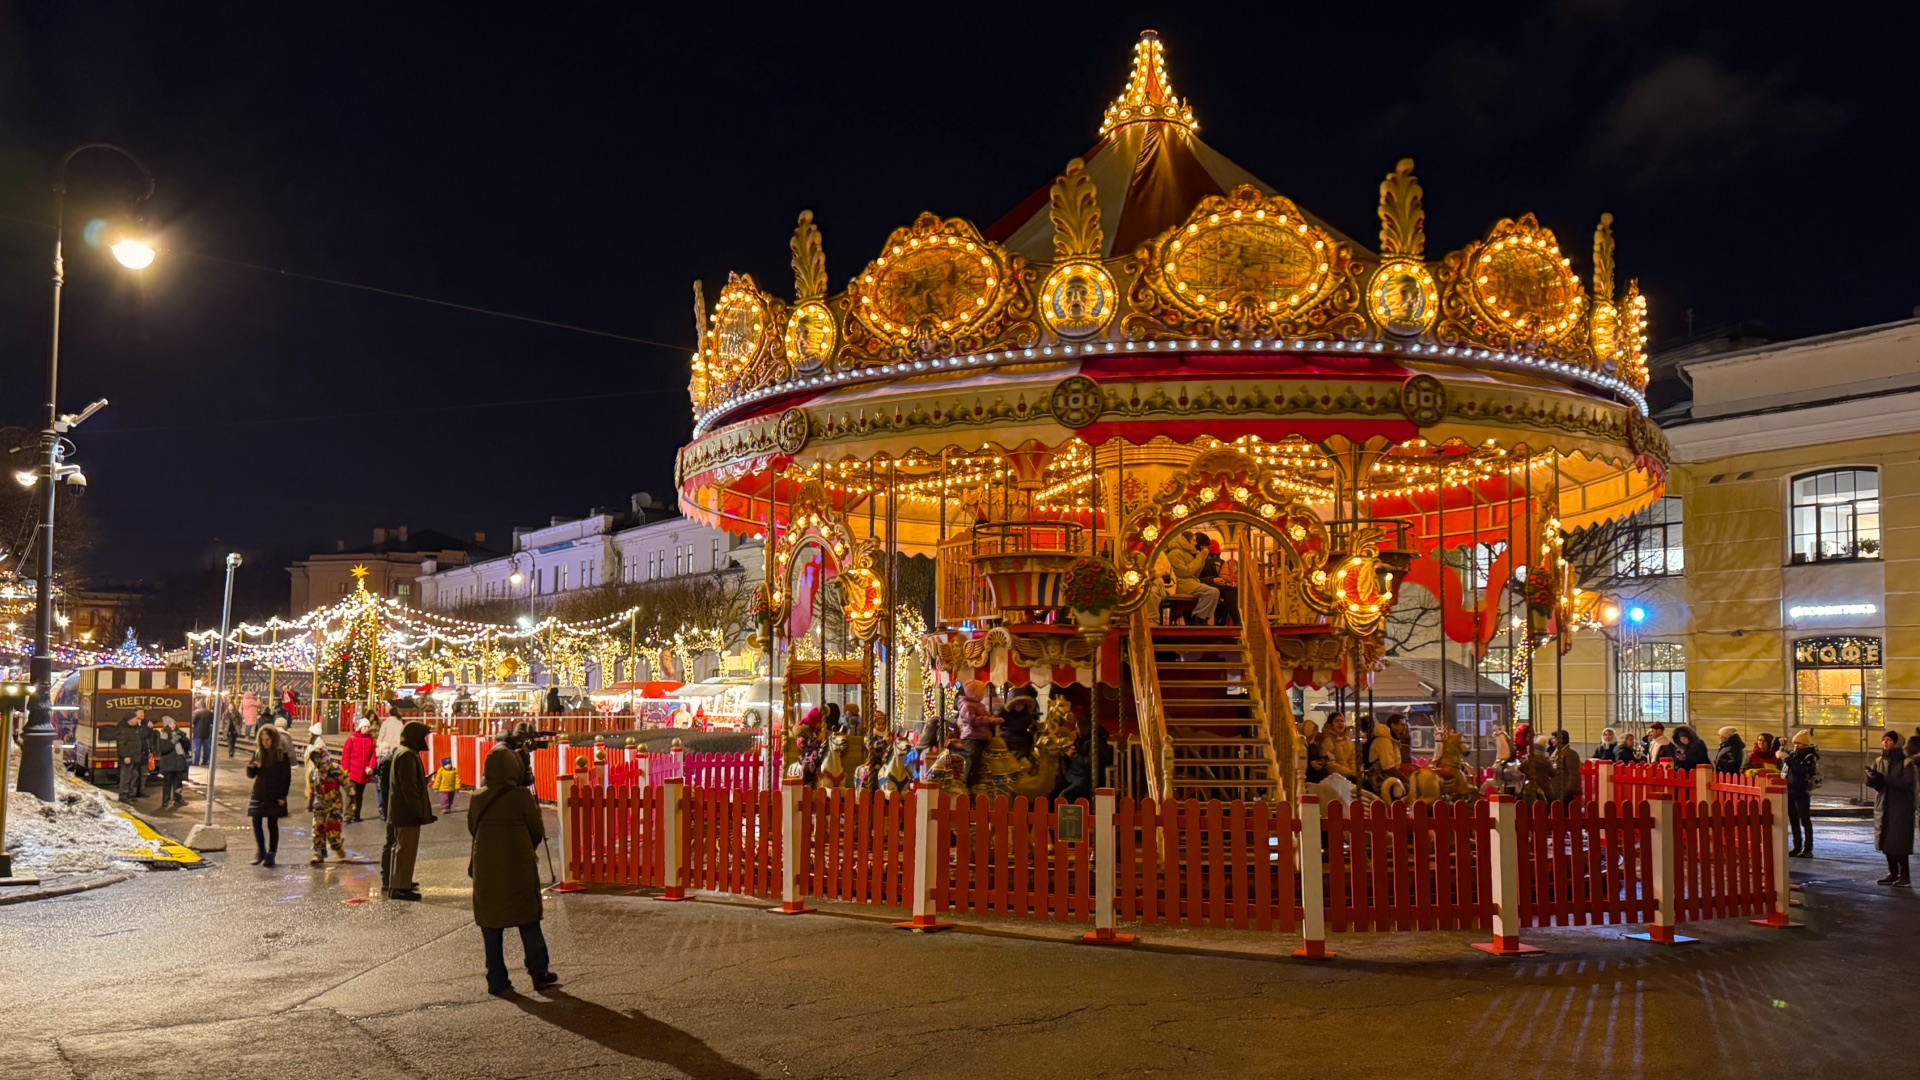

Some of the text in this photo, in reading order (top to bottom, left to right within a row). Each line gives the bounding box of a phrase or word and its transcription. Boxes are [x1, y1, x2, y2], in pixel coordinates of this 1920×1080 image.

[1798, 645, 1879, 663] КОФЕ
[105, 696, 147, 709] STREET
[149, 696, 182, 709] FOOD
